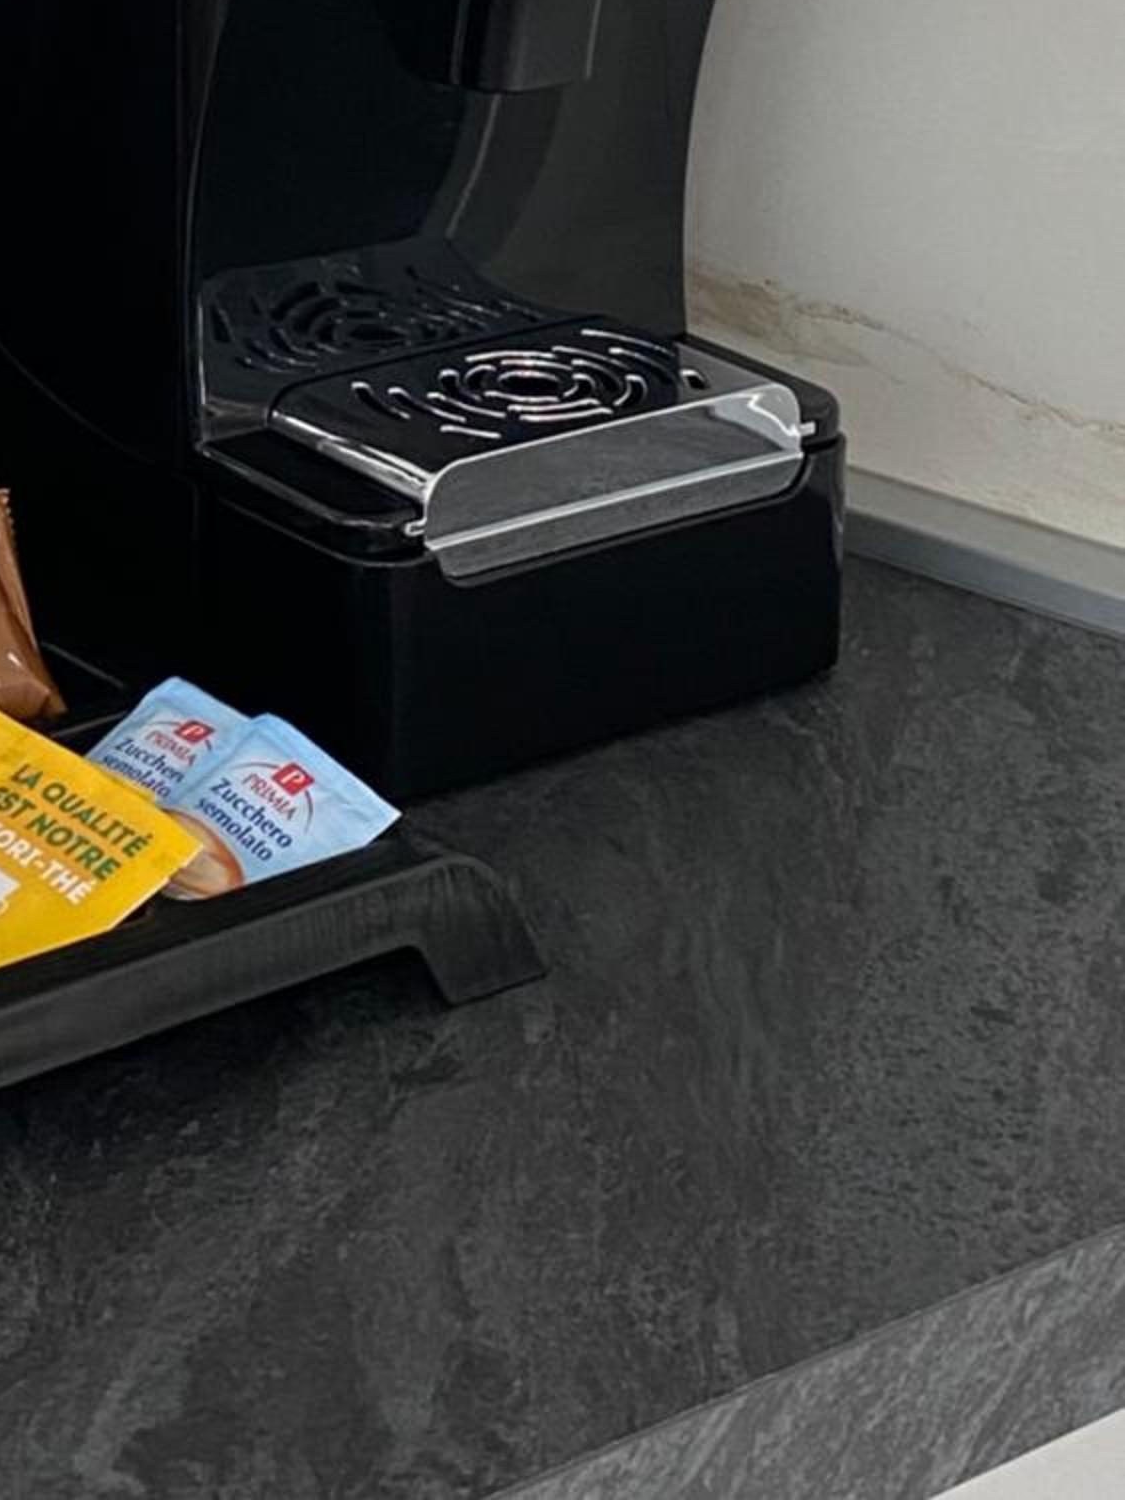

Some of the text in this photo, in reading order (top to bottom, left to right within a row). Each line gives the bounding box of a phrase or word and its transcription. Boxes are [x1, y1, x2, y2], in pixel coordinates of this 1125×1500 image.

[11, 762, 154, 859] LA QUALITÉ
[26, 811, 122, 882] NOTRE
[195, 798, 274, 863] semolato
[210, 776, 293, 850] Zucchero
